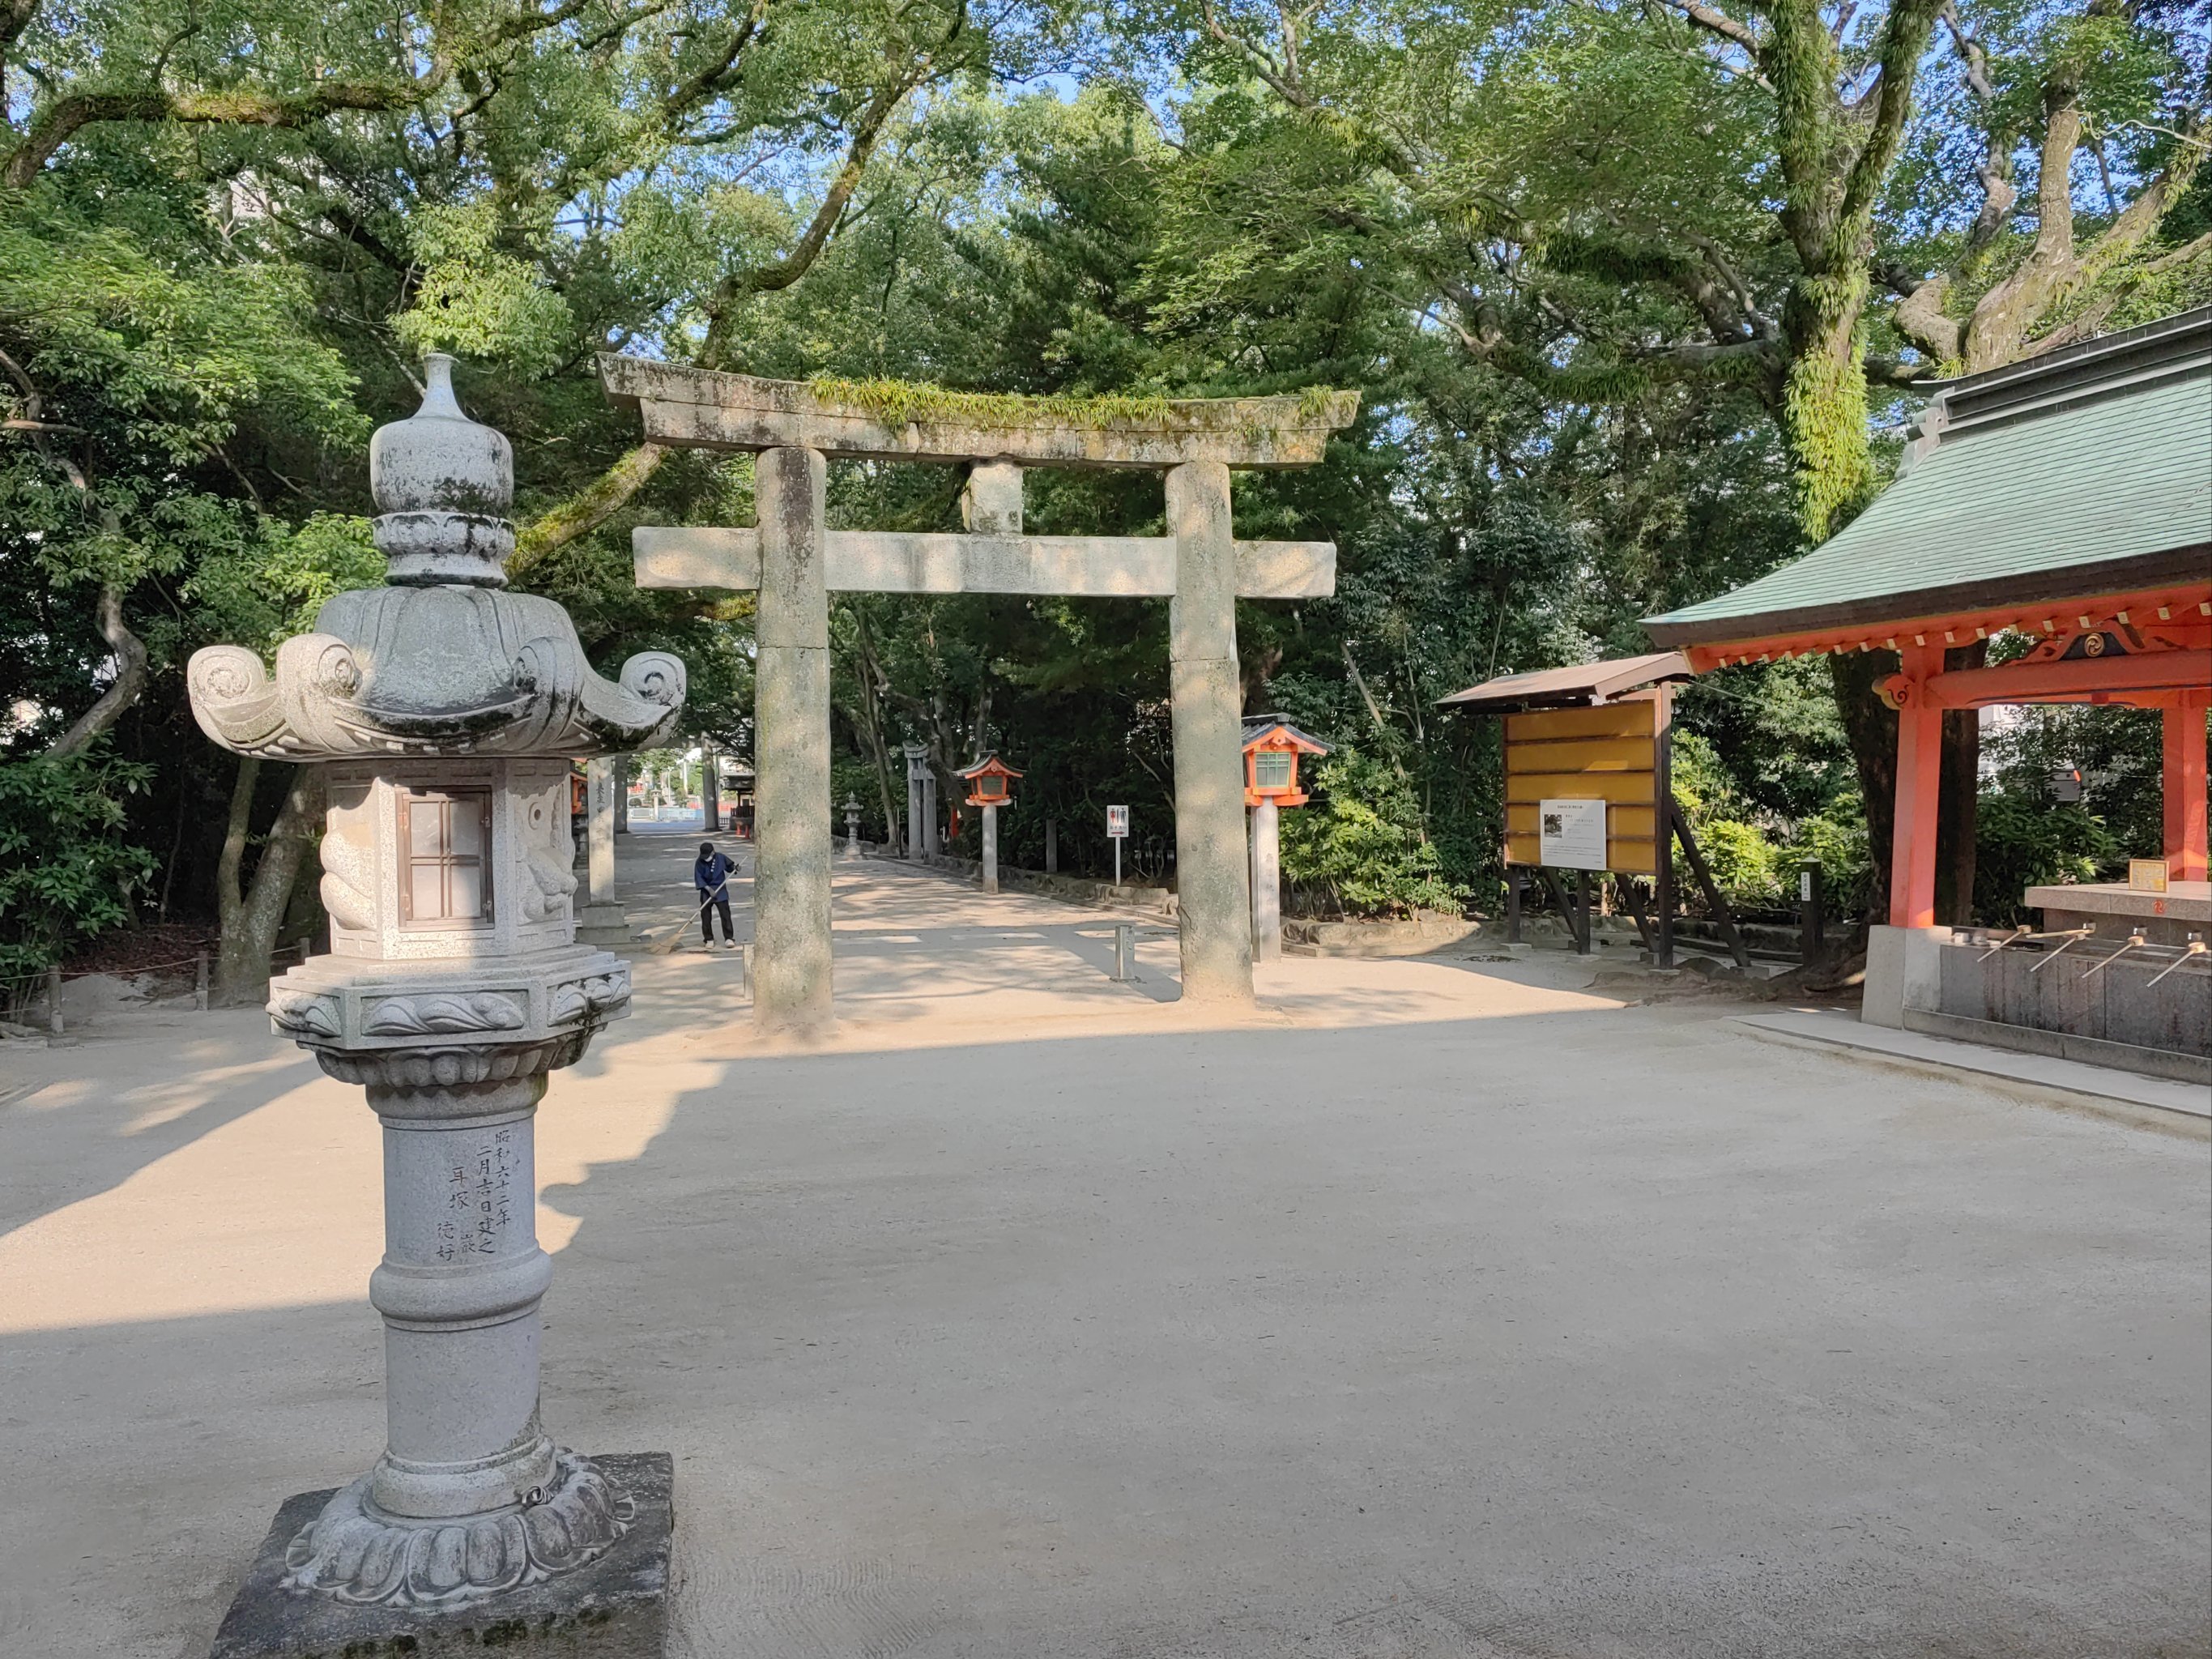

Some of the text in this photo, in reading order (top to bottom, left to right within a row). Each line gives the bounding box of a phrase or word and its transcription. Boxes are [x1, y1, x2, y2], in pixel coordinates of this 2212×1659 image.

[449, 1166, 470, 1209] 耳塚
[475, 1145, 497, 1254] 二月吉日建之
[493, 1129, 511, 1226] 昭和六十二年
